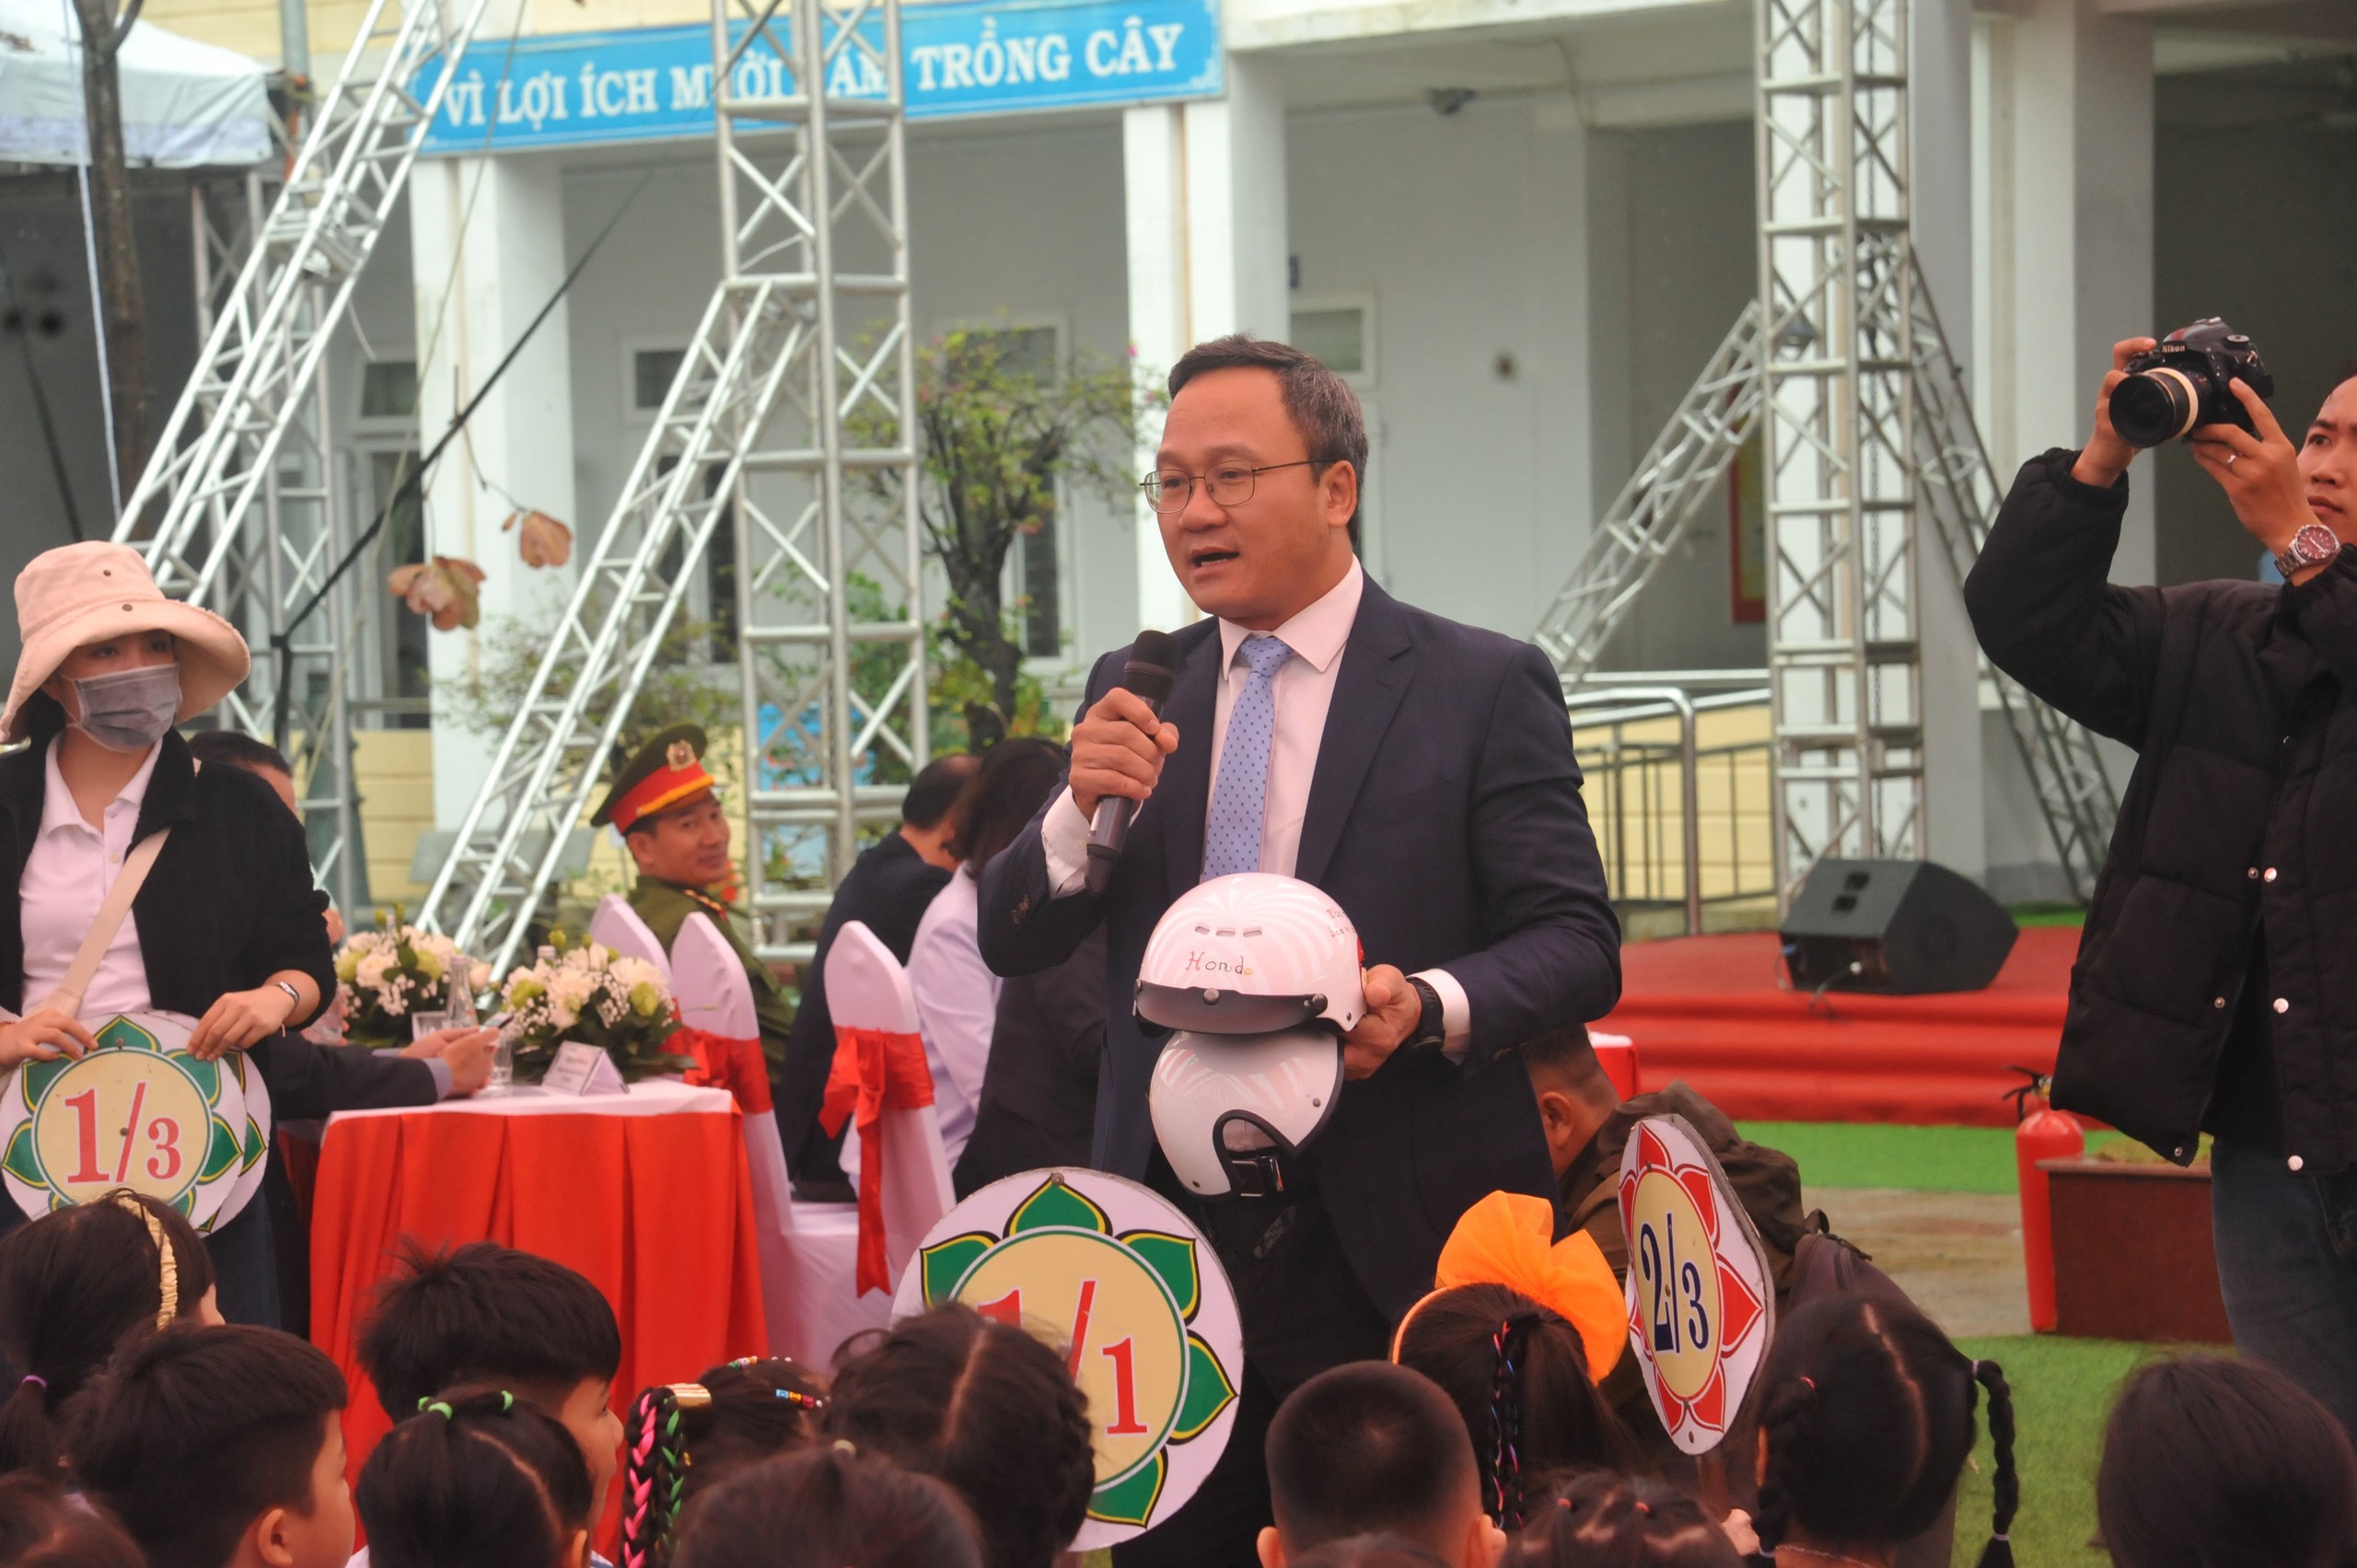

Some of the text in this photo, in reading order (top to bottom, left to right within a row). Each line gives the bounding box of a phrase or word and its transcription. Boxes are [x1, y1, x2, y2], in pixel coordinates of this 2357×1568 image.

[444, 68, 486, 127] VÌ
[497, 69, 568, 132] LỢI
[579, 61, 658, 118] ÍCH
[669, 46, 785, 110] MỜI
[910, 15, 1073, 91] TRỒNG
[1085, 15, 1185, 77] CÂY
[2161, 344, 2186, 354] Nikon
[1185, 950, 1255, 976] Honda
[64, 1082, 182, 1184] 1/3
[1640, 1212, 1709, 1354] 2/3
